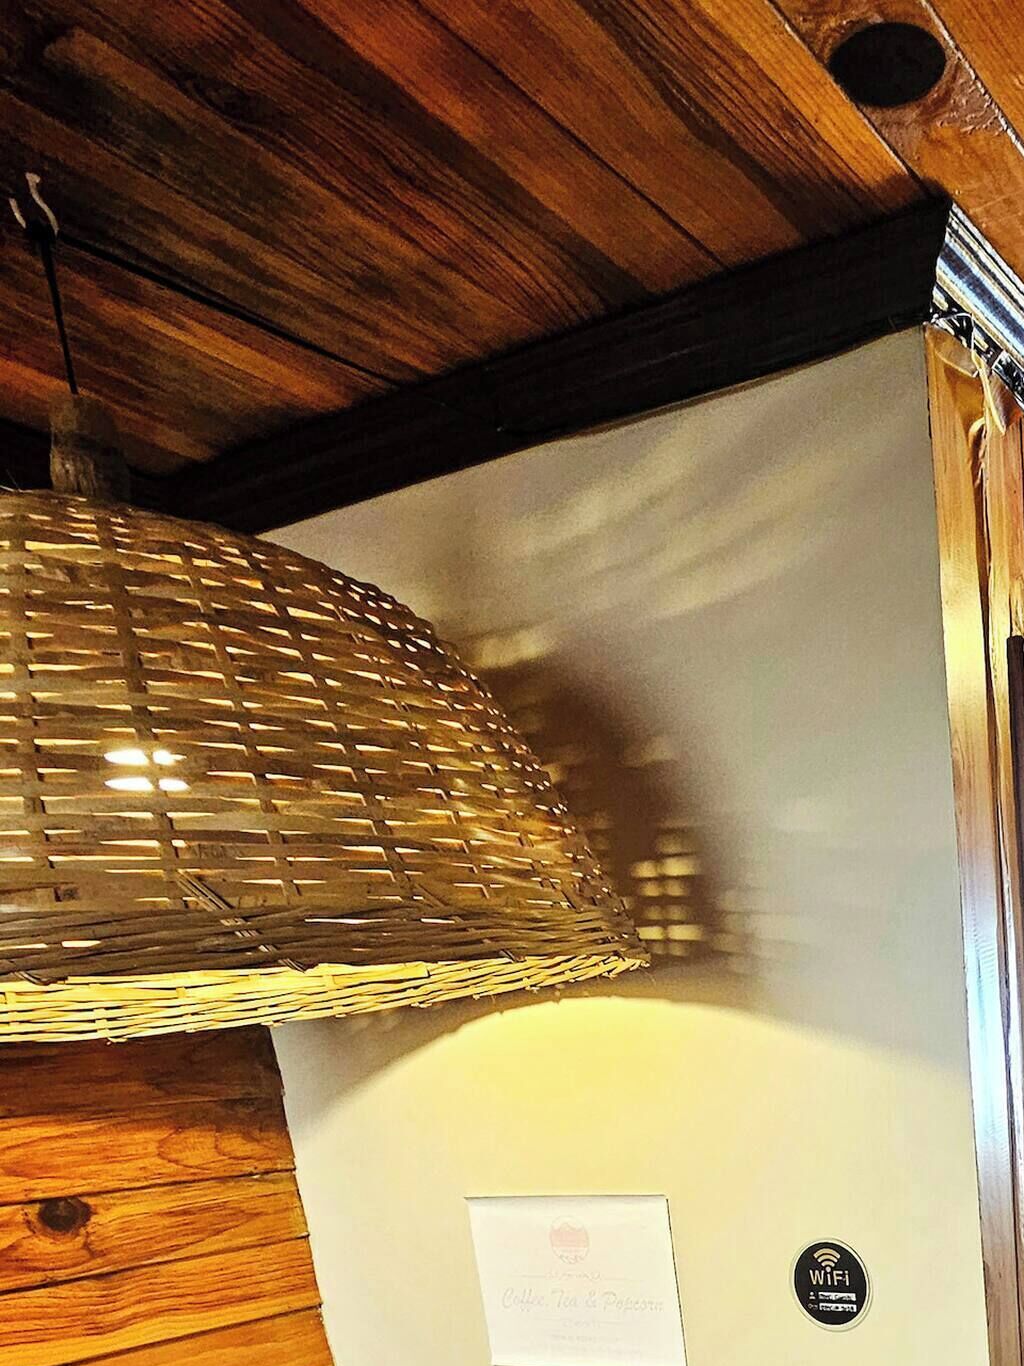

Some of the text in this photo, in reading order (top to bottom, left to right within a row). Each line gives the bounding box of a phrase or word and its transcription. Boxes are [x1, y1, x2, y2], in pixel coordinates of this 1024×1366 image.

[809, 1267, 849, 1286] WiFi
[551, 1288, 578, 1308] Tea
[602, 1290, 664, 1313] Popcorn
